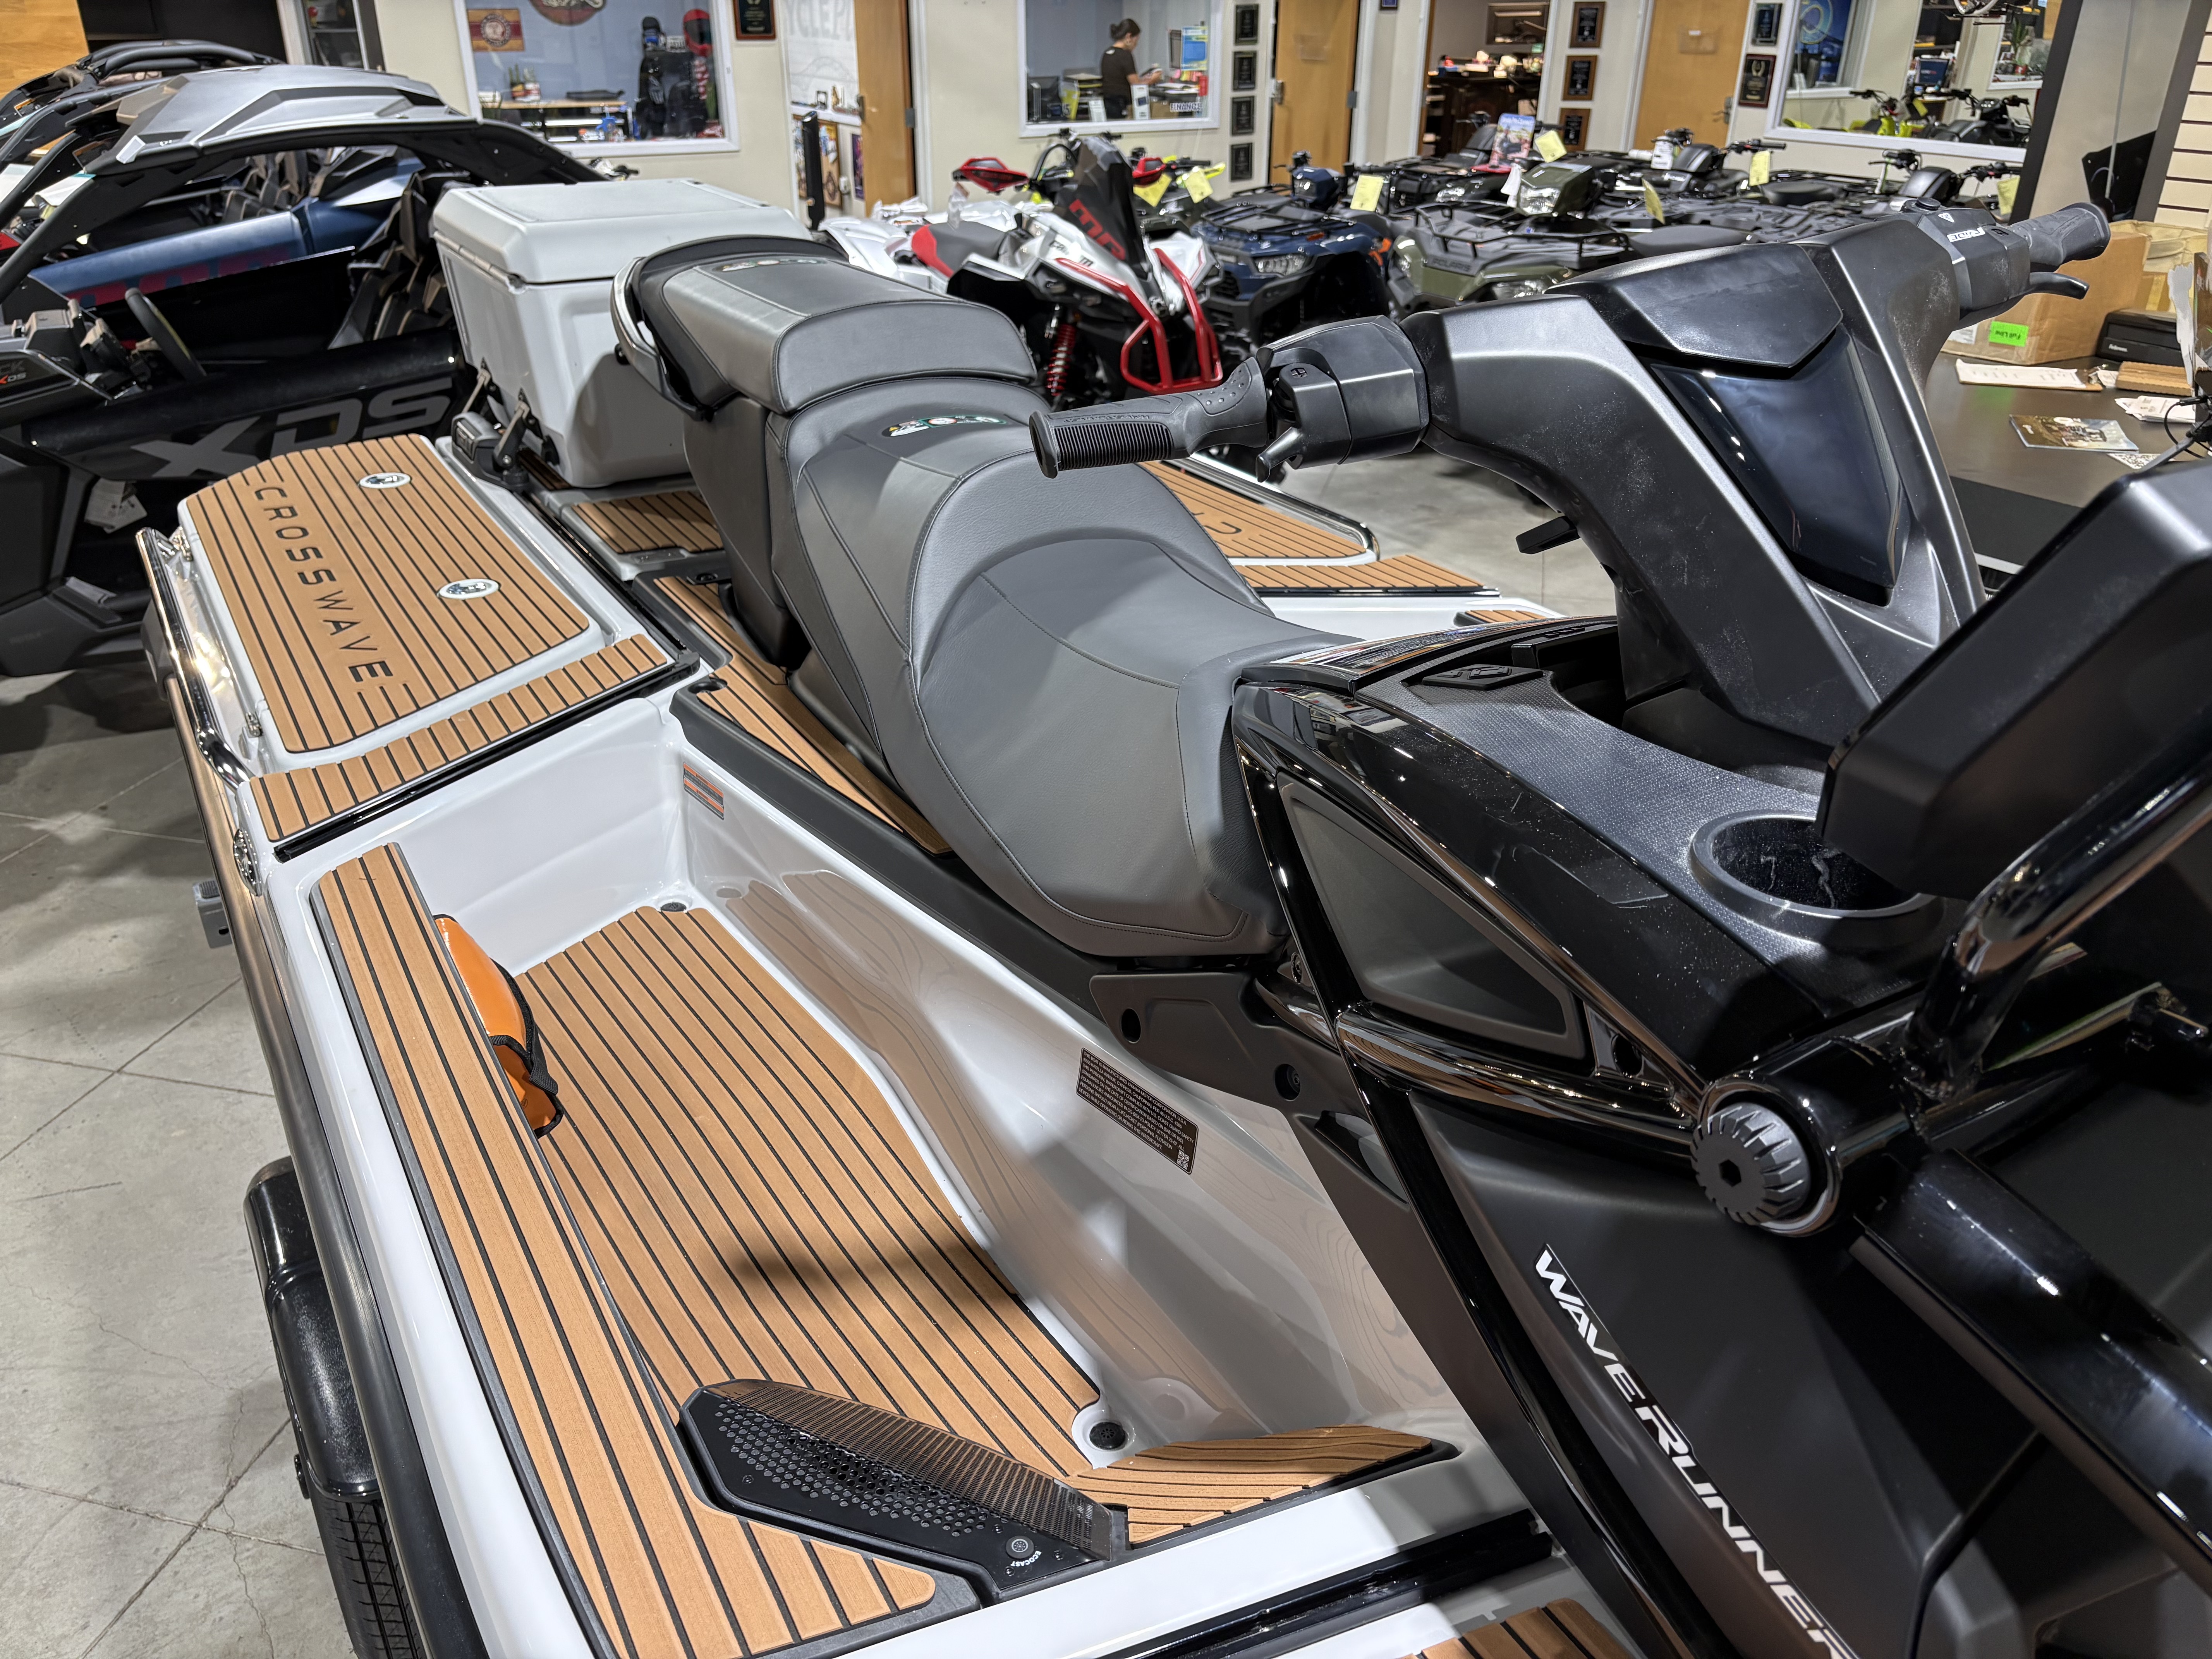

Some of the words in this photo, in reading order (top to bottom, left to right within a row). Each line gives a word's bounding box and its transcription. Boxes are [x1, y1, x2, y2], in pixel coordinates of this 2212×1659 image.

[1170, 102, 1202, 111] FINANCE
[131, 377, 452, 477] XDS
[254, 486, 394, 683] CROSSWAVE
[1081, 1074, 1104, 1094] EQUIVALENCIES
[1103, 1091, 1123, 1108] ANNOUNCED
[1144, 1119, 1156, 1131] POLICY
[1156, 1128, 1168, 1140] LETTER
[1082, 1068, 1099, 1084] STANDARDS
[1111, 1089, 1119, 1098] DATE
[1124, 1098, 1147, 1118] CERTIFICATION
[1147, 1114, 1158, 1126] BASED
[1089, 1068, 1105, 1082] PERSONAL
[1105, 1079, 1125, 1096] WATERCRAFT
[1125, 1093, 1142, 1108] COMPLIES
[1142, 1104, 1151, 1114] WITH
[1157, 1115, 1169, 1127] COAST
[1169, 1123, 1181, 1135] GUARD
[1181, 1132, 1194, 1144] SAFETY
[1091, 1062, 1104, 1075] KATELLA
[1116, 1080, 1132, 1095] CYPRESS,
[1102, 1064, 1127, 1084] MANUFACTURED
[1127, 1081, 1141, 1094] YAMAHA
[1140, 1091, 1153, 1102] MOTOR
[1080, 1080, 1094, 1094] PERSONS
[1094, 1091, 1107, 1103] SHOULD
[1107, 1099, 1116, 1110] WEAR
[1137, 1121, 1155, 1138] (PERSONAL
[1155, 1134, 1173, 1150] FLOTATION
[1090, 1094, 1099, 1105] WHILE
[1099, 1101, 1117, 1118] OPERATING
[1122, 1117, 1133, 1129] RIDING
[1010, 1550, 1042, 1567] ECOCAST
